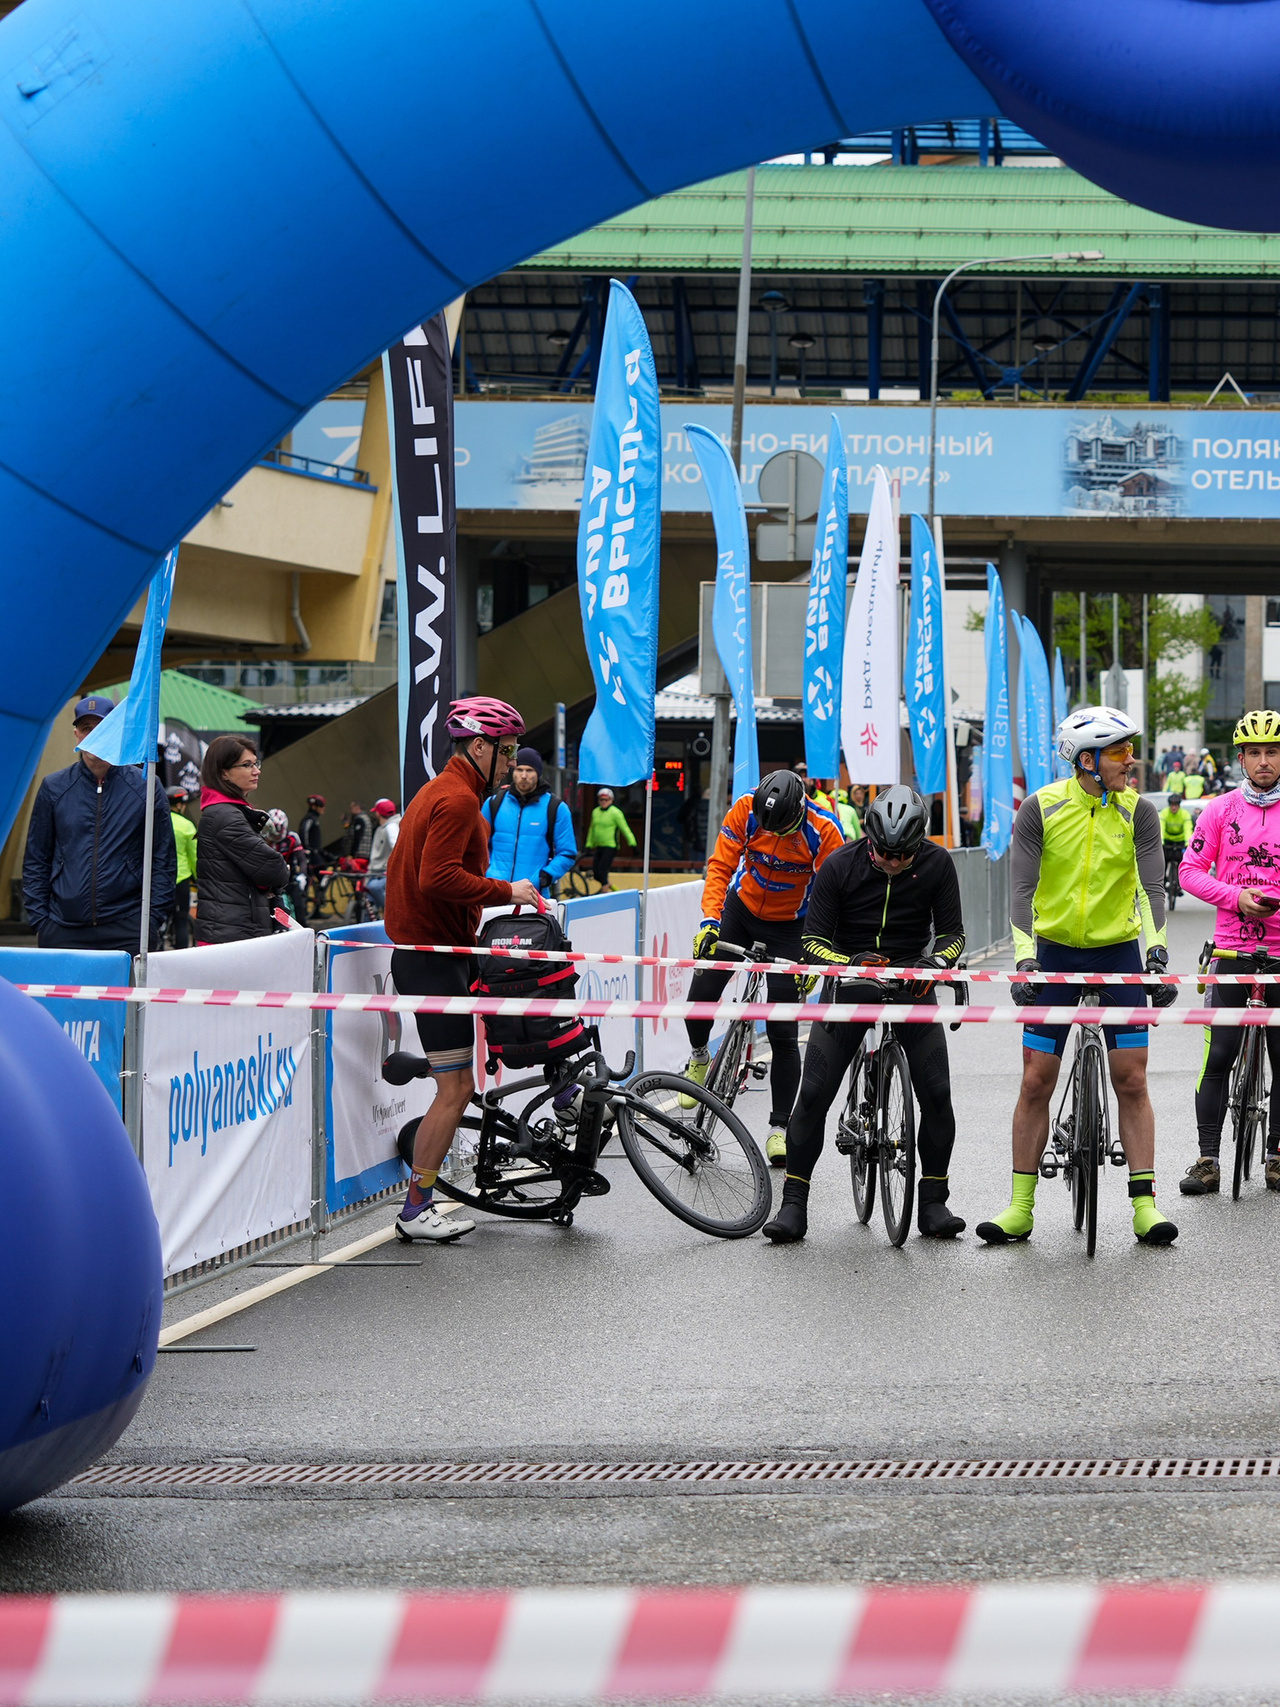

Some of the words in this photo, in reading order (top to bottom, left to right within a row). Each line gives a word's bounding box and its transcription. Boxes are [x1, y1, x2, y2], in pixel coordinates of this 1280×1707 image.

[663, 431, 993, 456] ЛНО-БИТЛОННЫЙ
[846, 465, 951, 487] ЛАУРА»
[413, 556, 446, 780] A.W.
[491, 935, 532, 946] IRONMAN
[168, 1033, 298, 1168] polyanaski.ru
